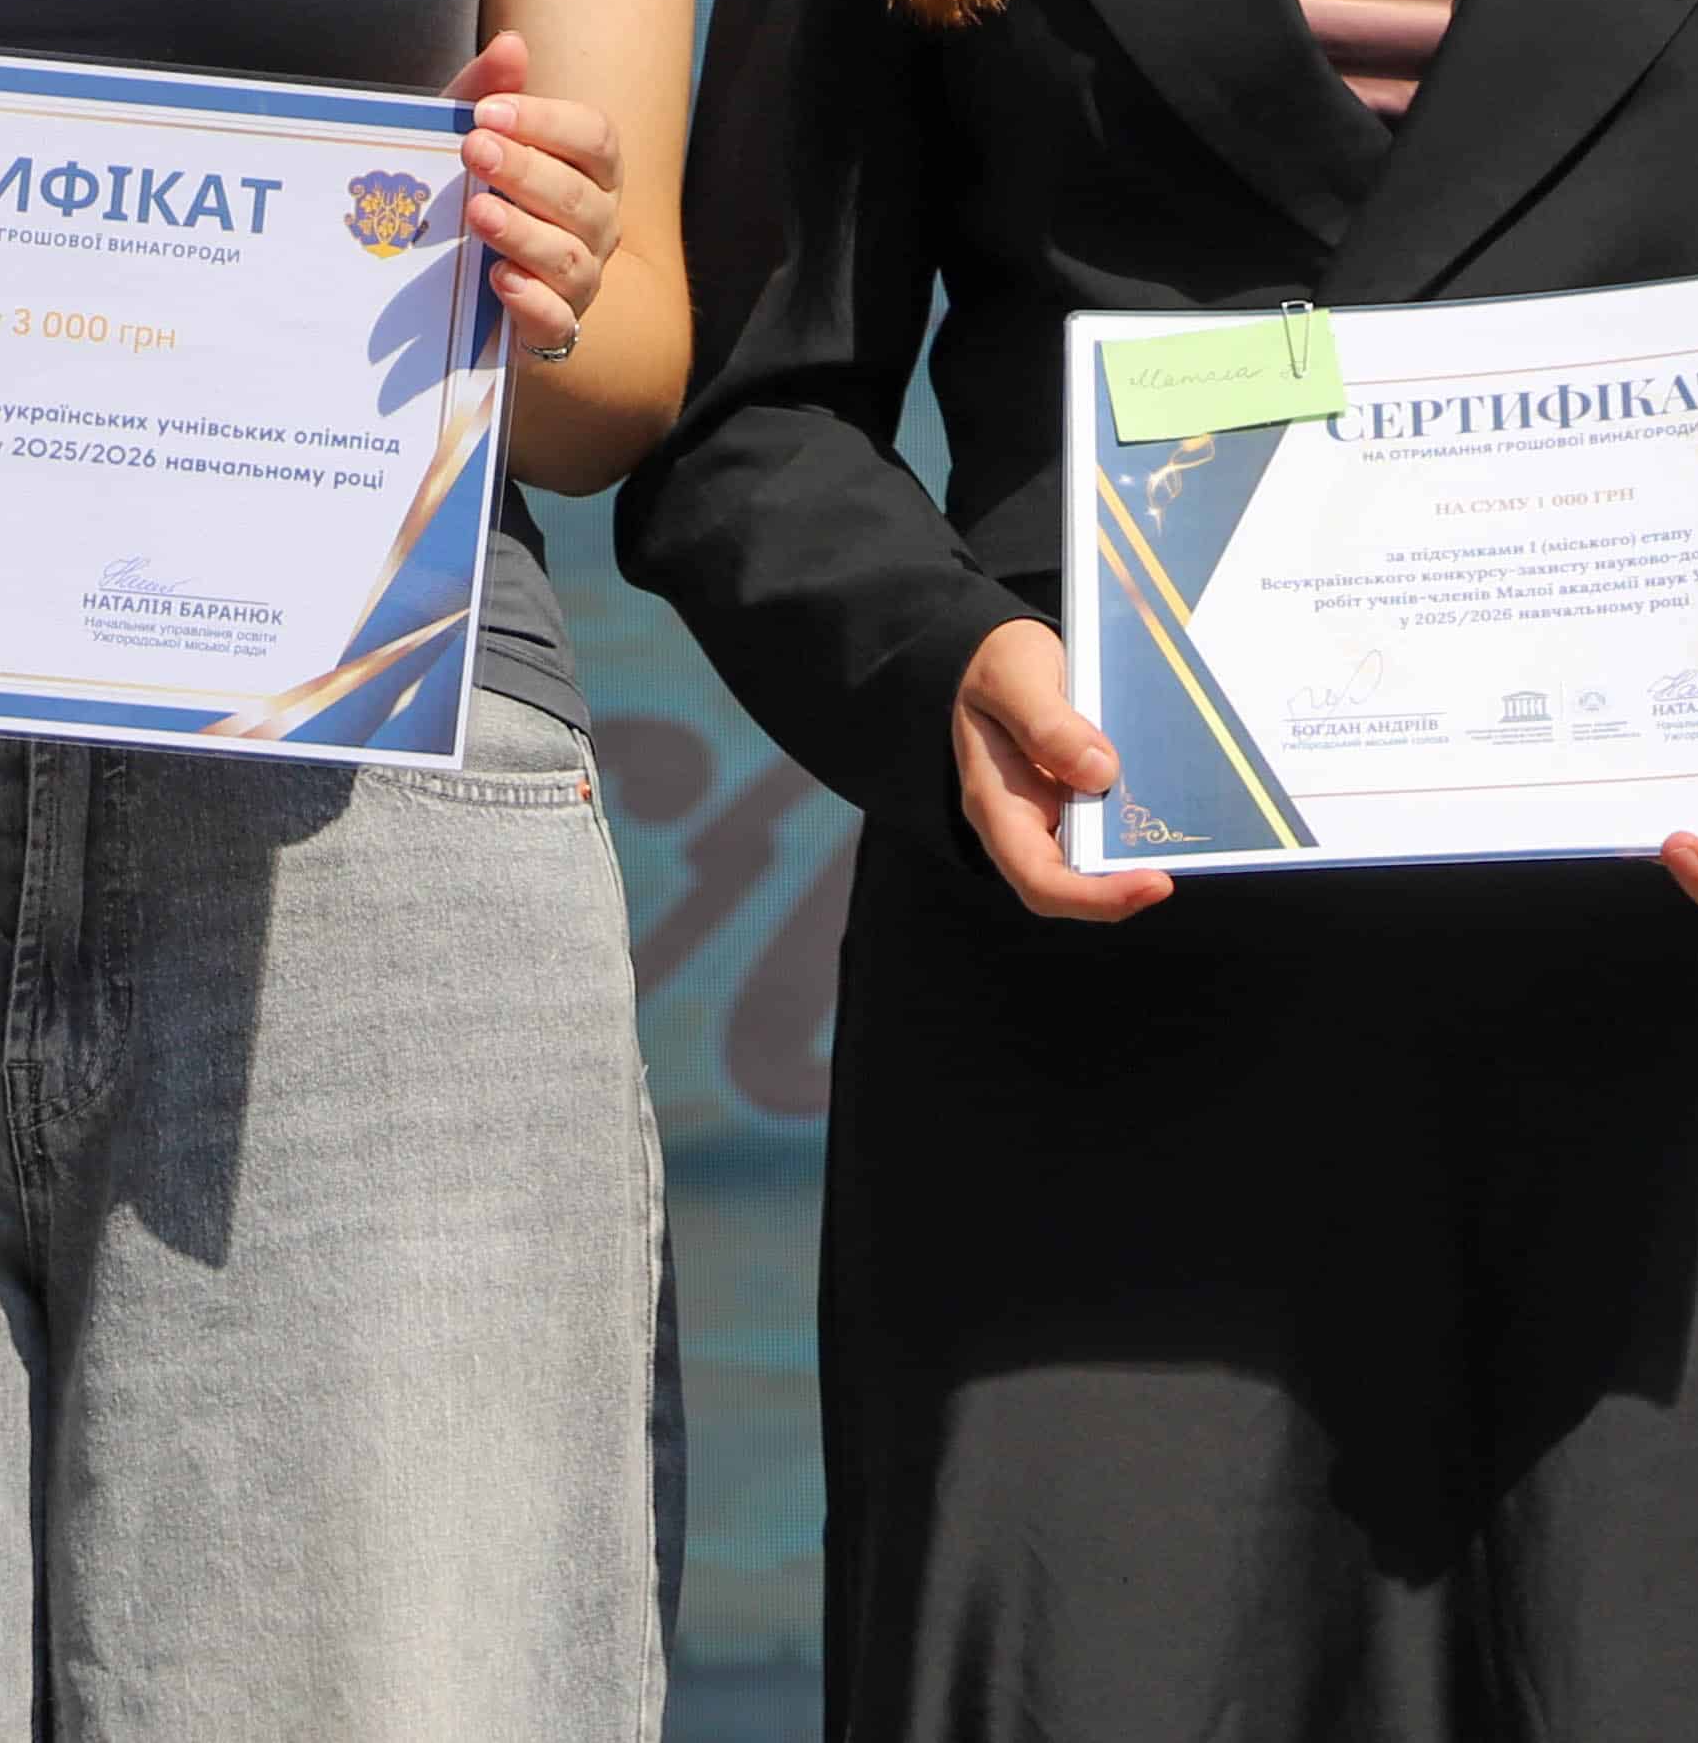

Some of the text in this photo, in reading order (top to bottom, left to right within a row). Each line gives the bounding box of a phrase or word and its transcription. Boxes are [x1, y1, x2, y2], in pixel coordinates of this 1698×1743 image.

[107, 238, 240, 264] ВИНАГОРОДИ
[12, 307, 31, 336] 3
[42, 311, 109, 342] 000
[119, 324, 175, 353] грн
[157, 417, 285, 441] учнівських
[293, 428, 399, 454] олімпіад
[1362, 450, 1384, 462] НА
[1388, 443, 1492, 459] ОТРИМАННЯ
[1496, 433, 1584, 451] ГРОШОВОЇ
[11, 437, 156, 467] 2025/2026
[165, 457, 325, 486] навчальному
[333, 470, 383, 490] році
[1435, 502, 1465, 515] НА
[1470, 497, 1529, 512] СУМУ
[1550, 493, 1588, 506] 000
[1593, 487, 1634, 503] ГРН
[1386, 552, 1404, 562] за
[1410, 545, 1524, 562] підсумками
[1541, 533, 1636, 554] (міського)
[1640, 529, 1692, 543] етапу
[1260, 574, 1415, 591] Всеукраїнського
[1314, 594, 1362, 612] робіт
[1496, 583, 1553, 598] Малої
[1558, 576, 1638, 594] академії
[1644, 574, 1687, 588] наук
[82, 593, 282, 624] НАТАЛІЯ БАРАНЮК
[1414, 608, 1513, 625] 2025/2026
[1518, 601, 1644, 619] навчальному
[1649, 593, 1690, 612] році
[1291, 717, 1440, 737] БОГДАН АНДРІЇВ
